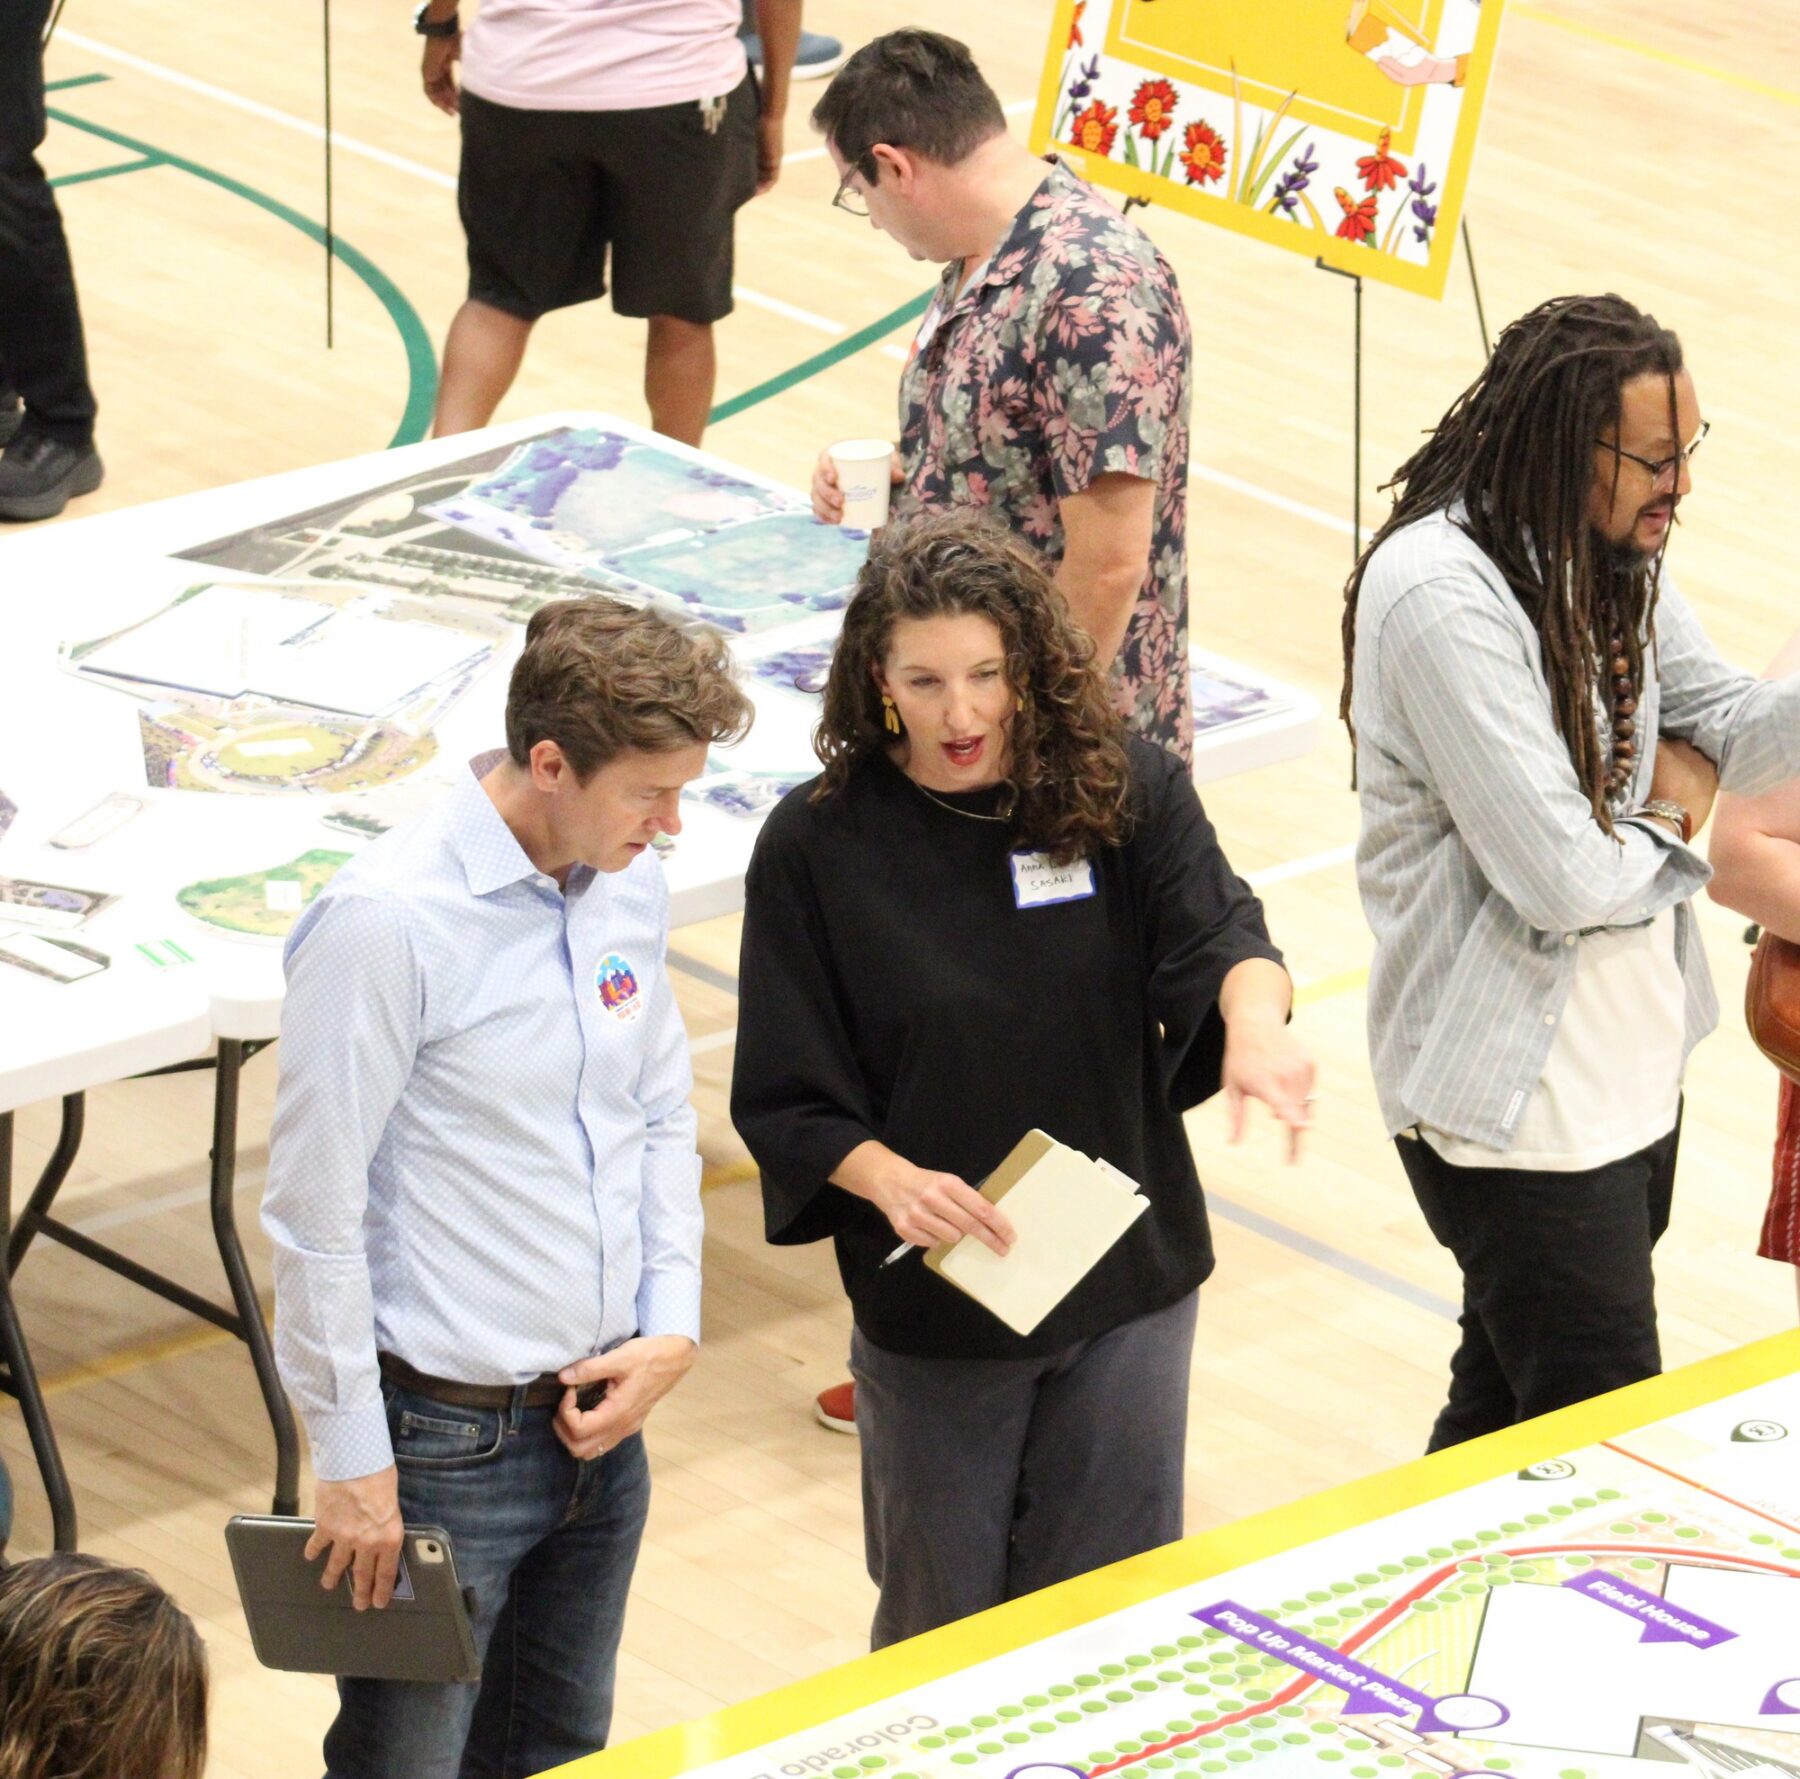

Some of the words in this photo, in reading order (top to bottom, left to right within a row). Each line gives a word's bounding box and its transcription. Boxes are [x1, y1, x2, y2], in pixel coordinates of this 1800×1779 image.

[1031, 874, 1073, 890] SASAKI
[1586, 1580, 1647, 1609] Field
[1642, 1605, 1711, 1641] House
[1214, 1610, 1260, 1635] Pop
[1257, 1630, 1290, 1650] Up
[1286, 1646, 1366, 1687] Market
[780, 1714, 939, 1777] Colorado
